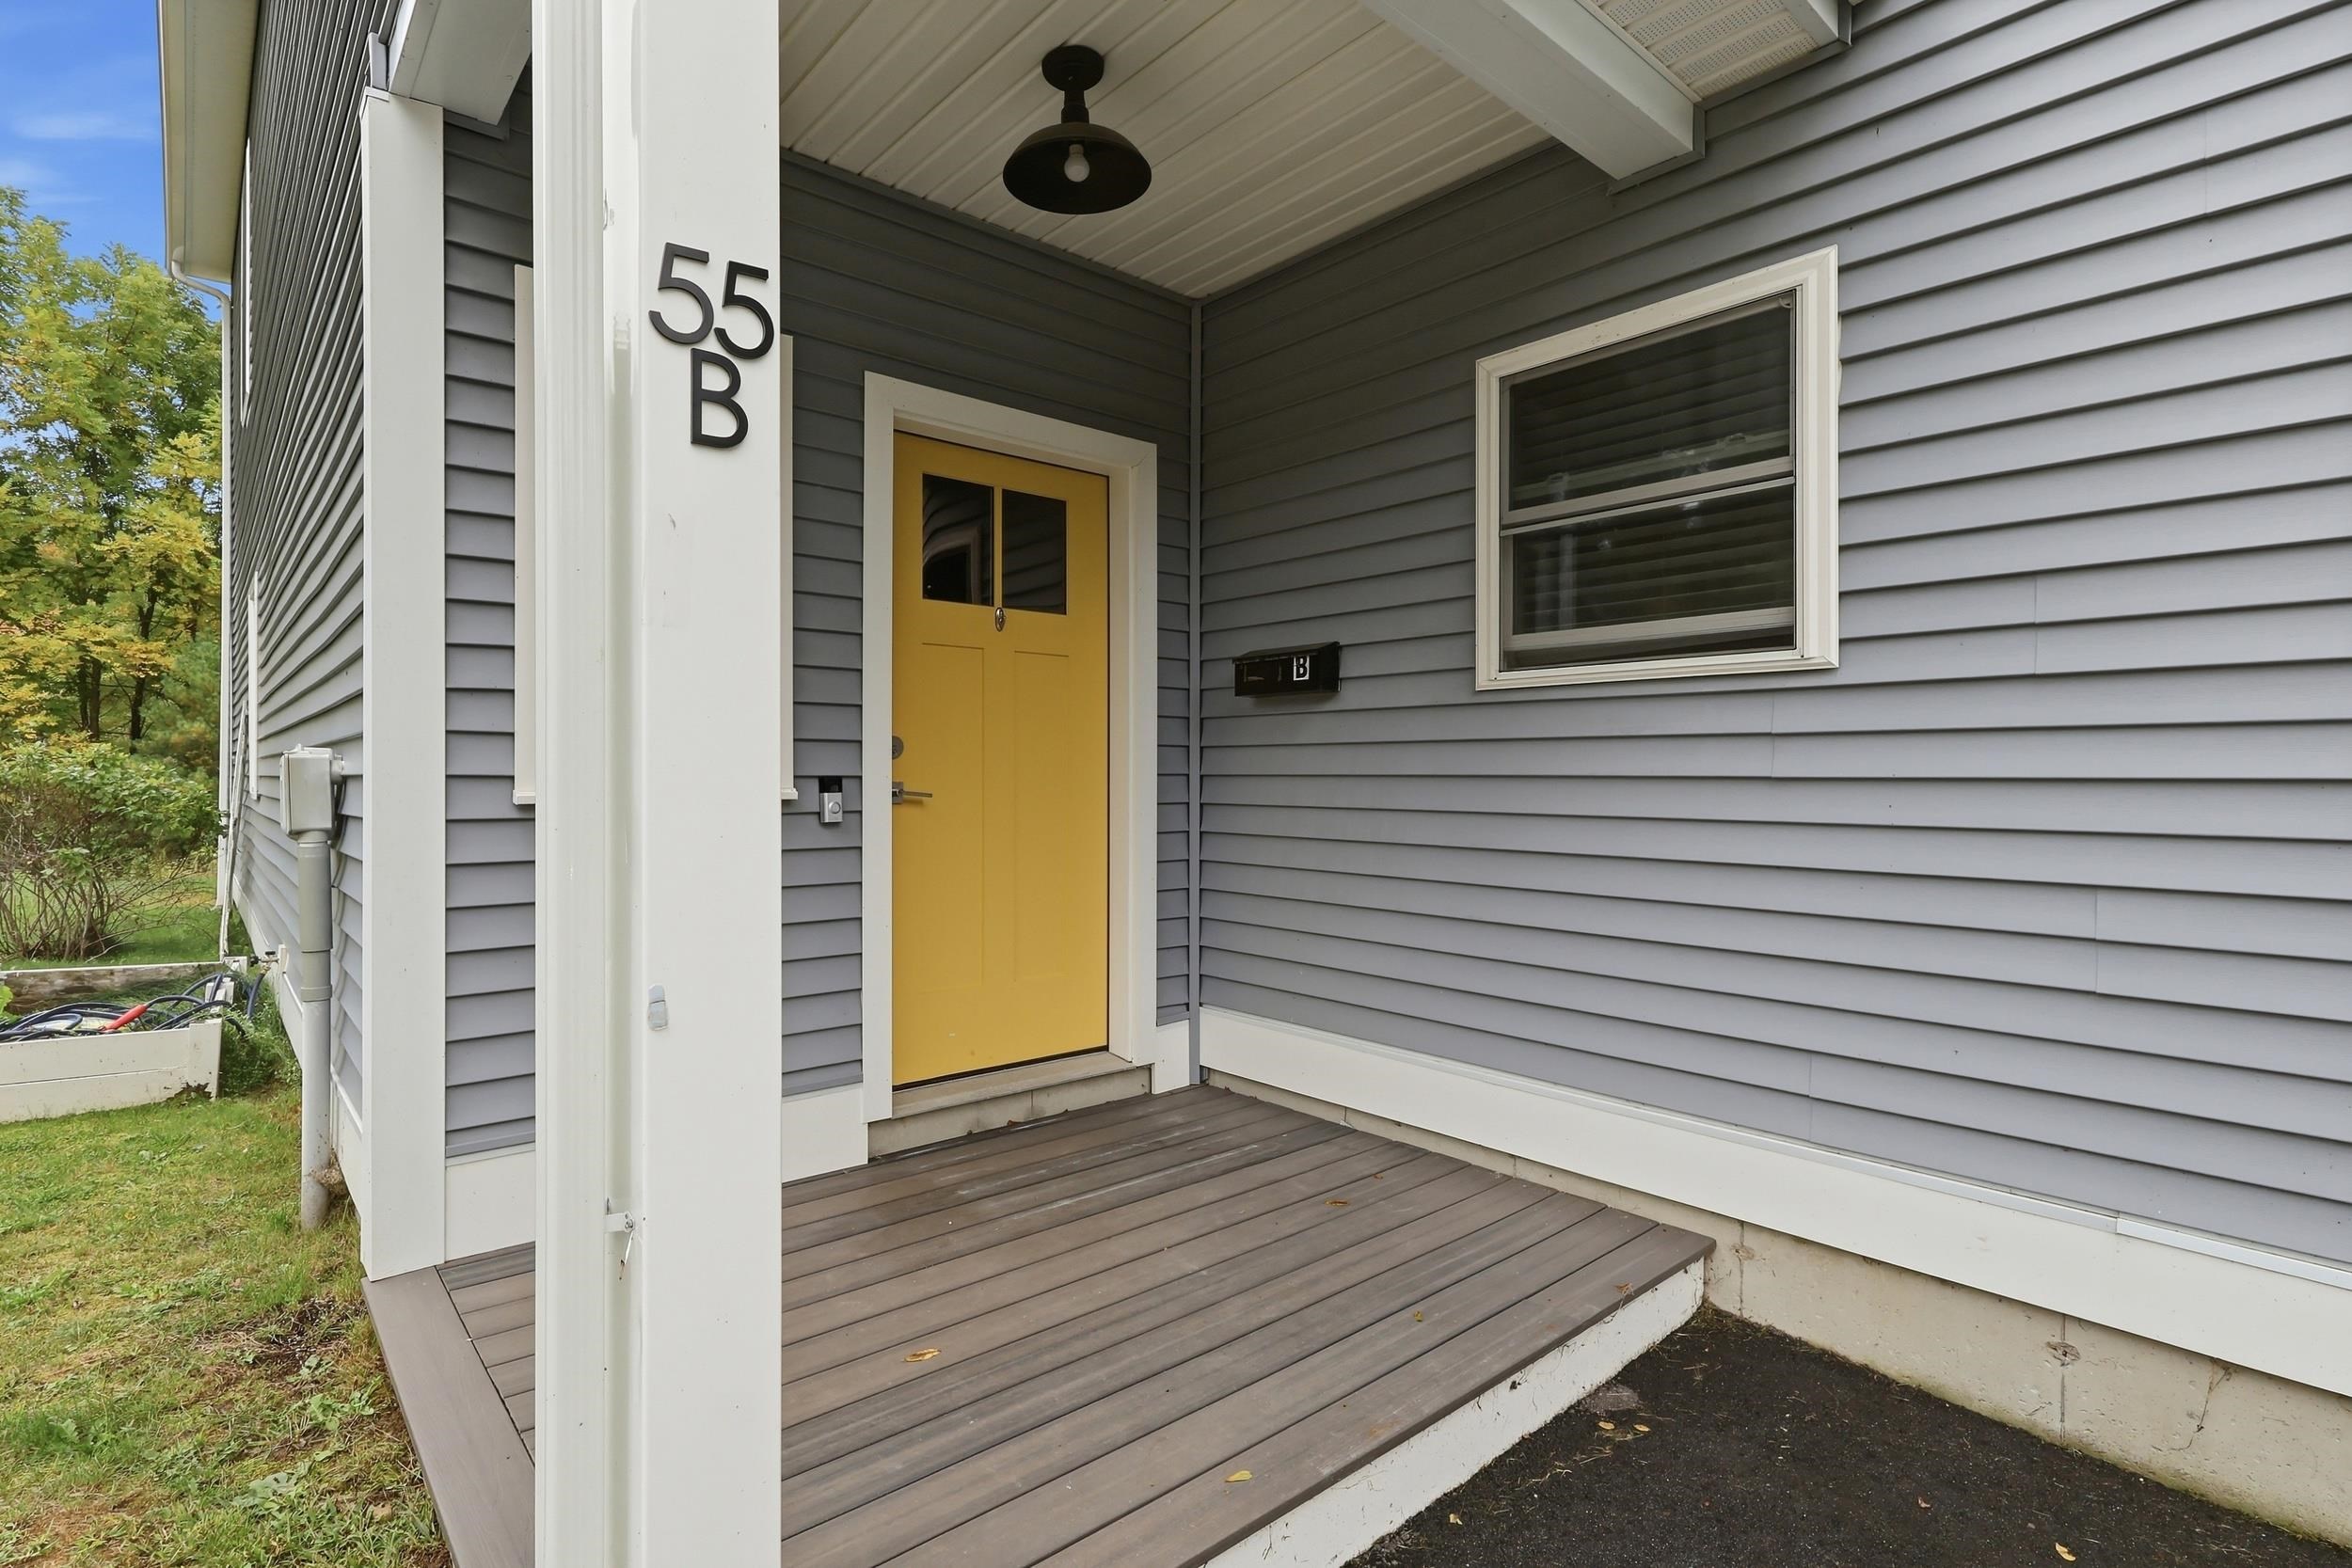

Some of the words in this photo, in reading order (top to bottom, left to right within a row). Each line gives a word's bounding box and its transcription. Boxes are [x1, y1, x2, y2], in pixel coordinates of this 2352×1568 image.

[648, 242, 774, 359] 55
[691, 347, 748, 448] B
[1295, 656, 1309, 679] B
